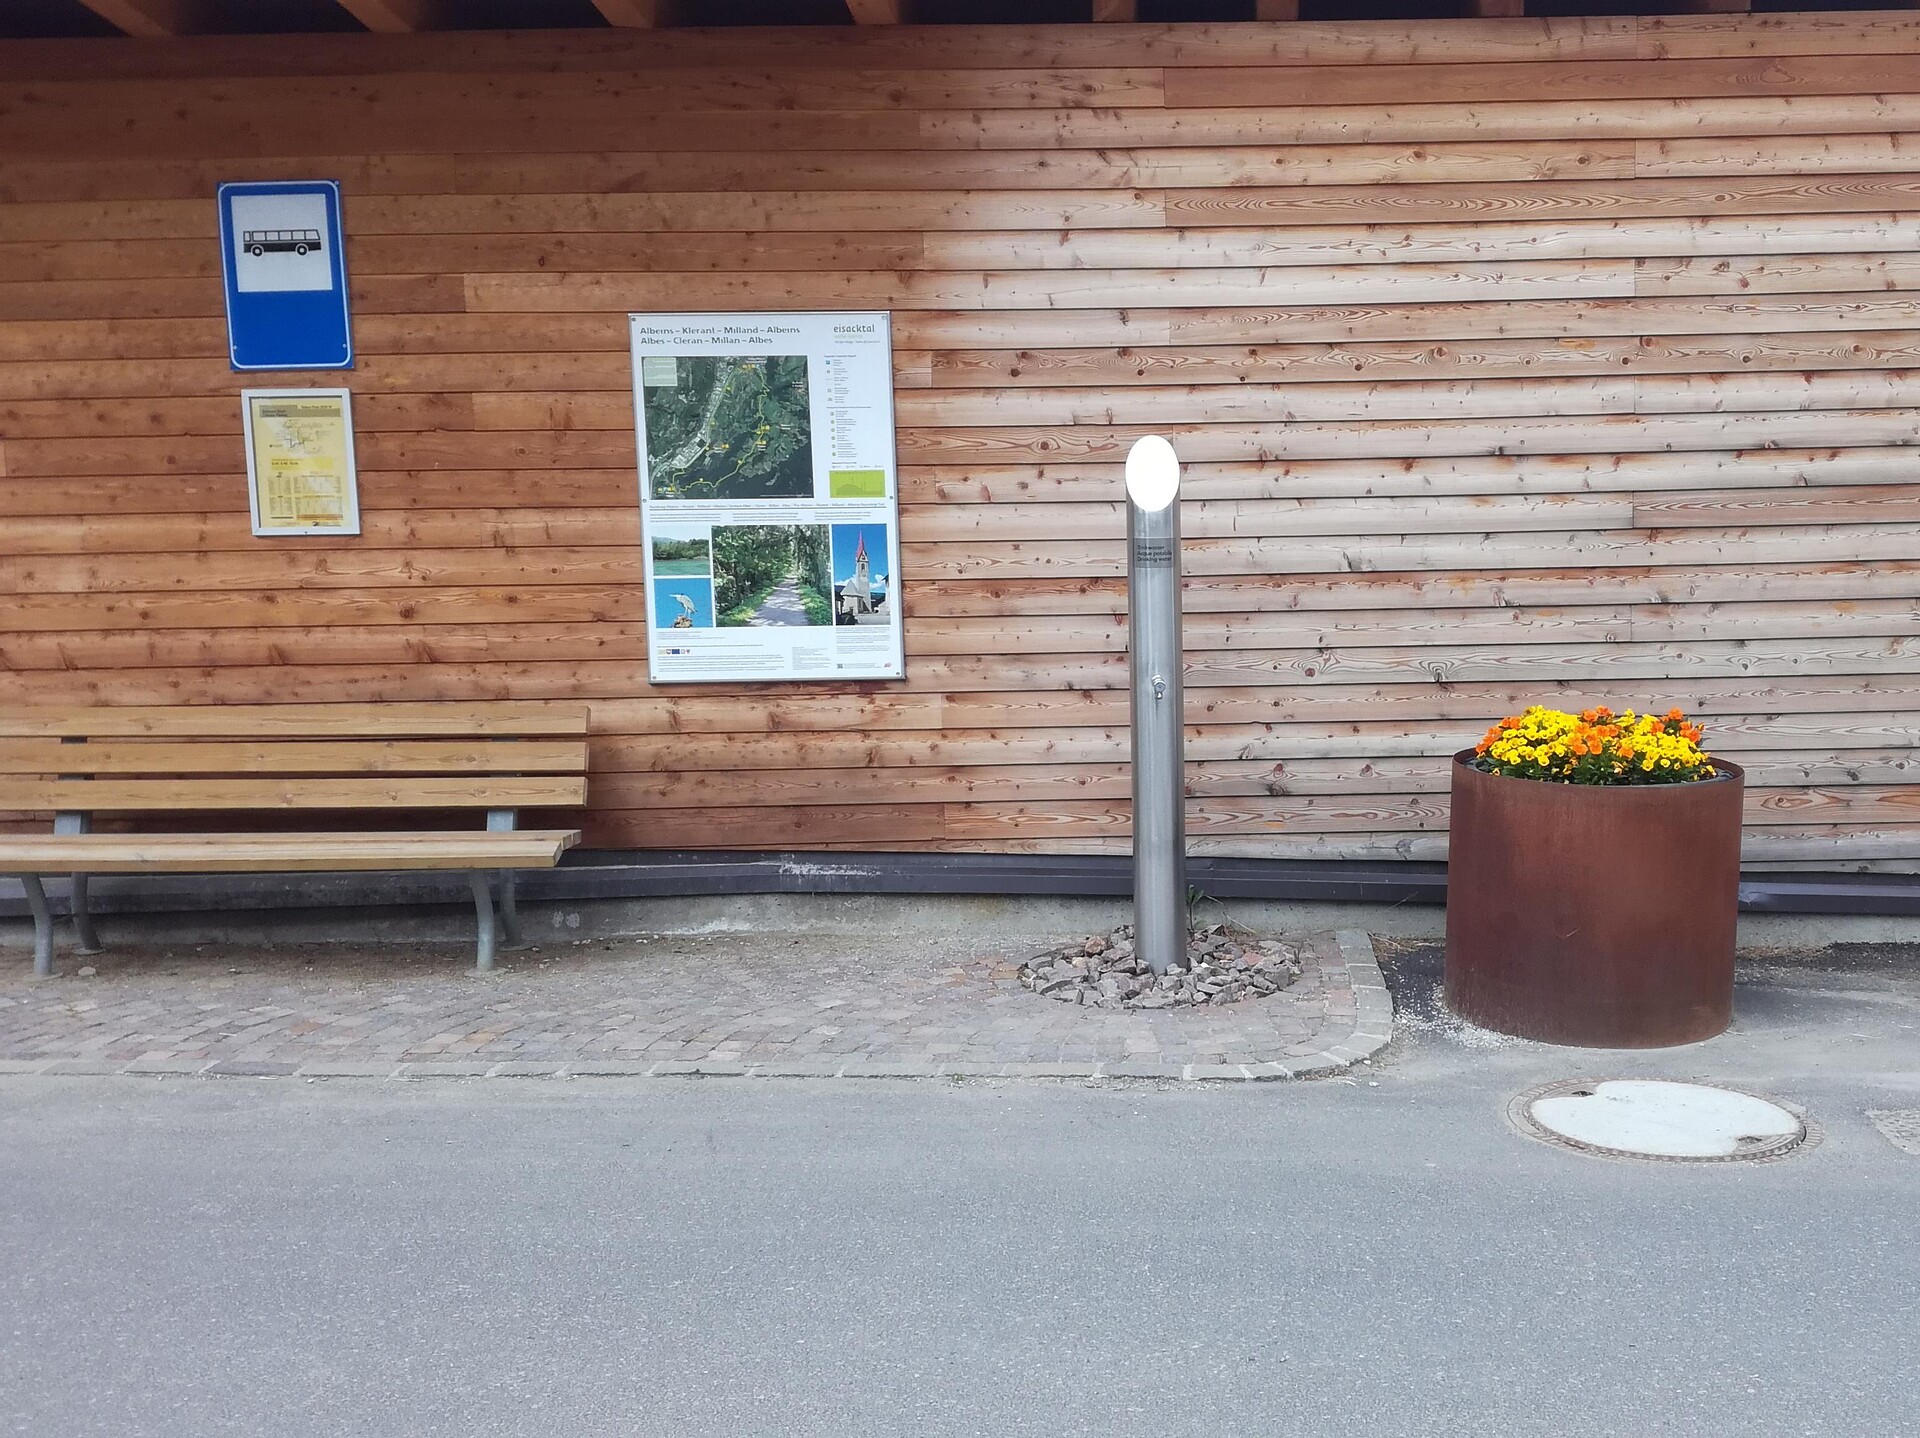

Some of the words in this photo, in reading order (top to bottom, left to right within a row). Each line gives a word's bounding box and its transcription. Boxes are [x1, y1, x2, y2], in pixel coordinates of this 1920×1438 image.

[724, 326, 759, 334] Milland
[766, 326, 801, 334] Albeins
[833, 324, 875, 333] eisacktal
[640, 337, 665, 345] Albes
[711, 336, 741, 344] Millan
[748, 336, 773, 344] Albes
